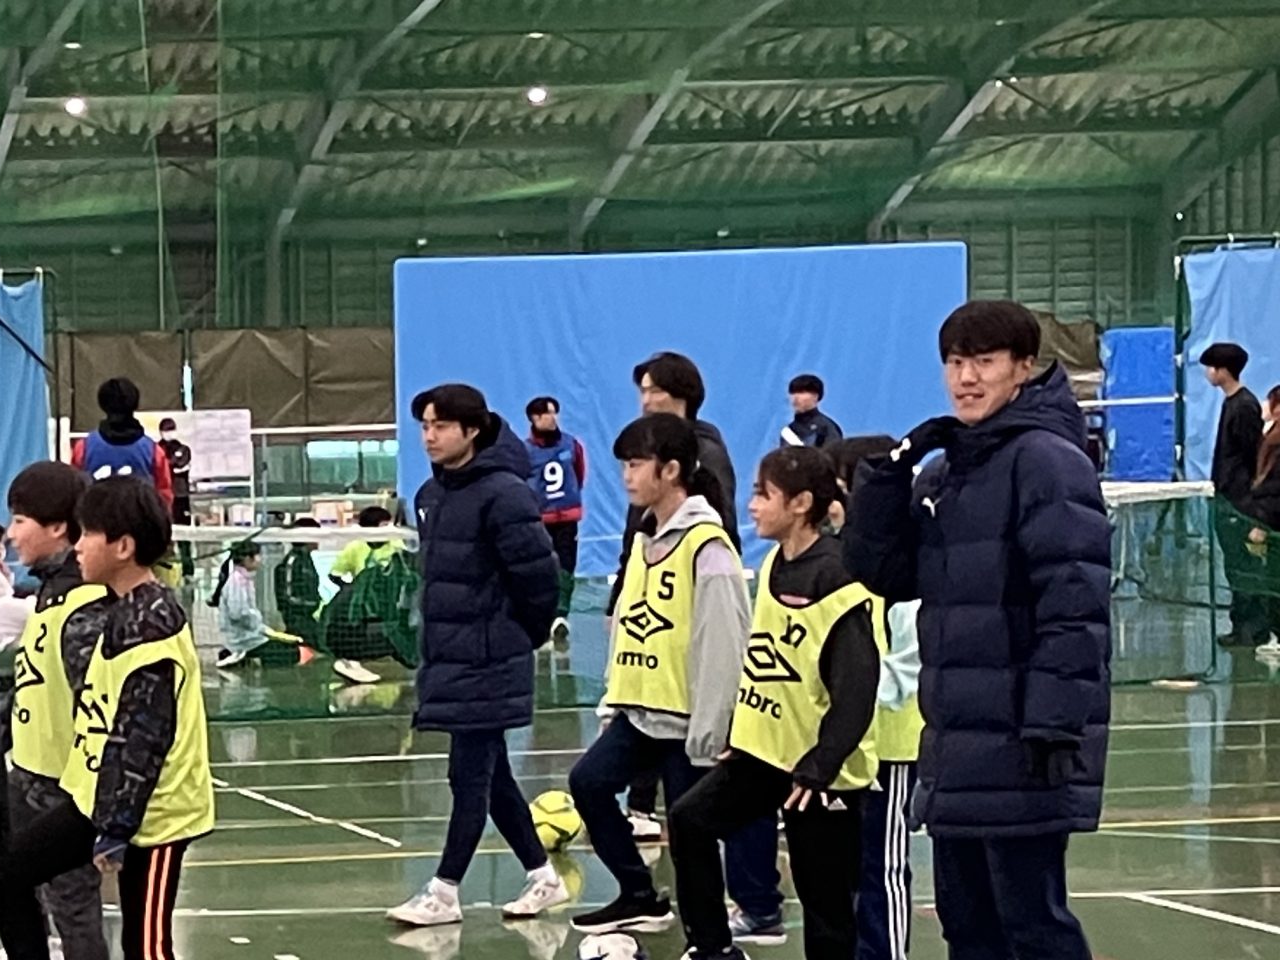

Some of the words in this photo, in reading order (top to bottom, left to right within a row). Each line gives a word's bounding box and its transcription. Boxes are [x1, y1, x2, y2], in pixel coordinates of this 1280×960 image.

[544, 461, 564, 492] 9
[658, 571, 675, 600] 5
[35, 623, 47, 653] 2
